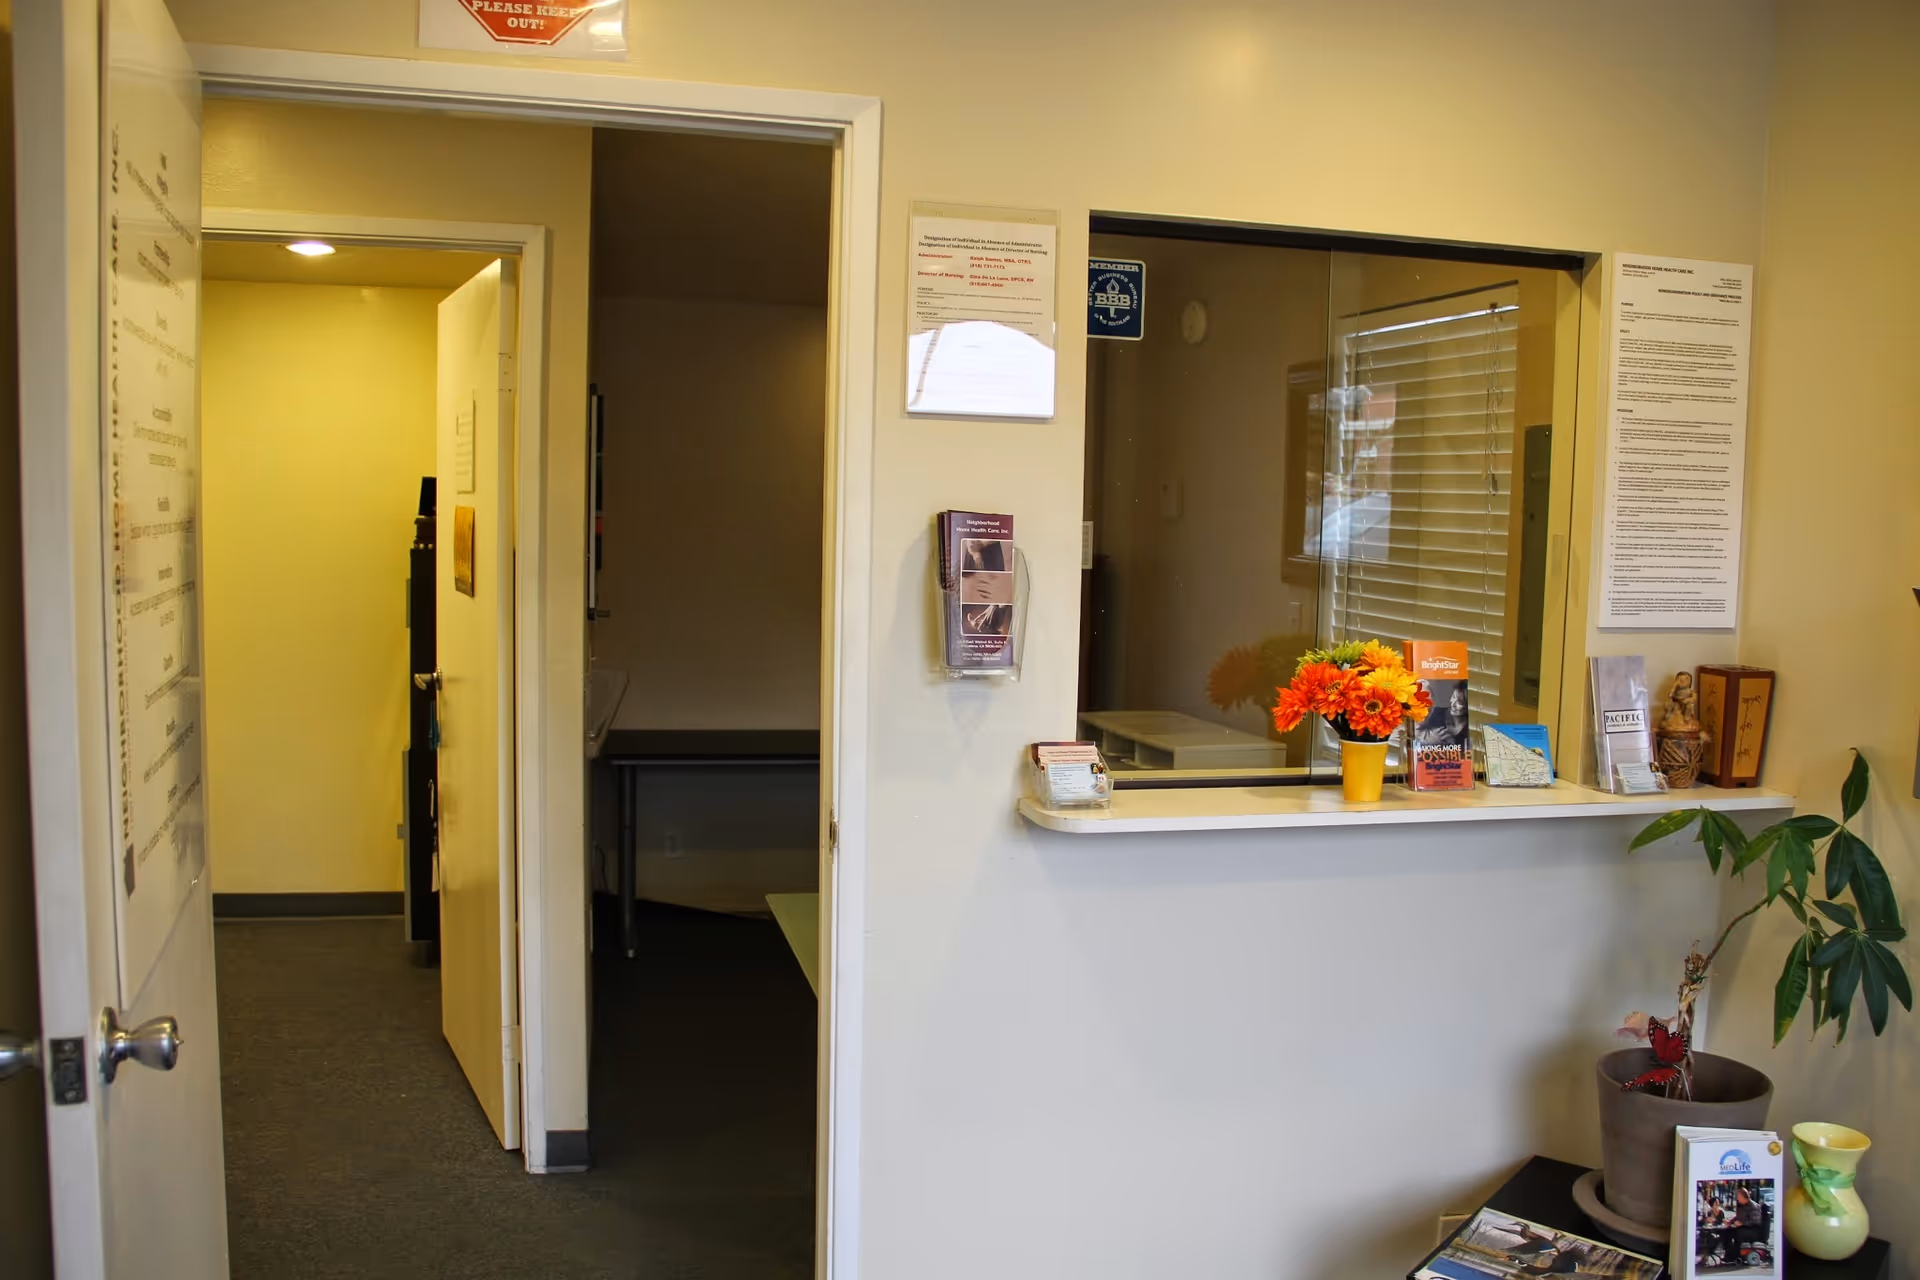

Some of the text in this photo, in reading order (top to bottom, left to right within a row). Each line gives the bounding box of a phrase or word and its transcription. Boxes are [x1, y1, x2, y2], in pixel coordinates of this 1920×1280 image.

[472, 0, 581, 18] PLEASE KEEP
[506, 17, 545, 30] OUT!
[1090, 262, 1139, 272] MEMBER
[1097, 272, 1129, 283] BUSINESS
[1128, 282, 1138, 309] BUREAU
[1094, 292, 1131, 306] BBB
[112, 452, 120, 551] HOME
[1422, 660, 1459, 671] BrightStar
[114, 564, 129, 841] NEIGHBORHOOD
[1605, 713, 1643, 723] PACIFIC
[1417, 750, 1472, 762] POSSIBLE
